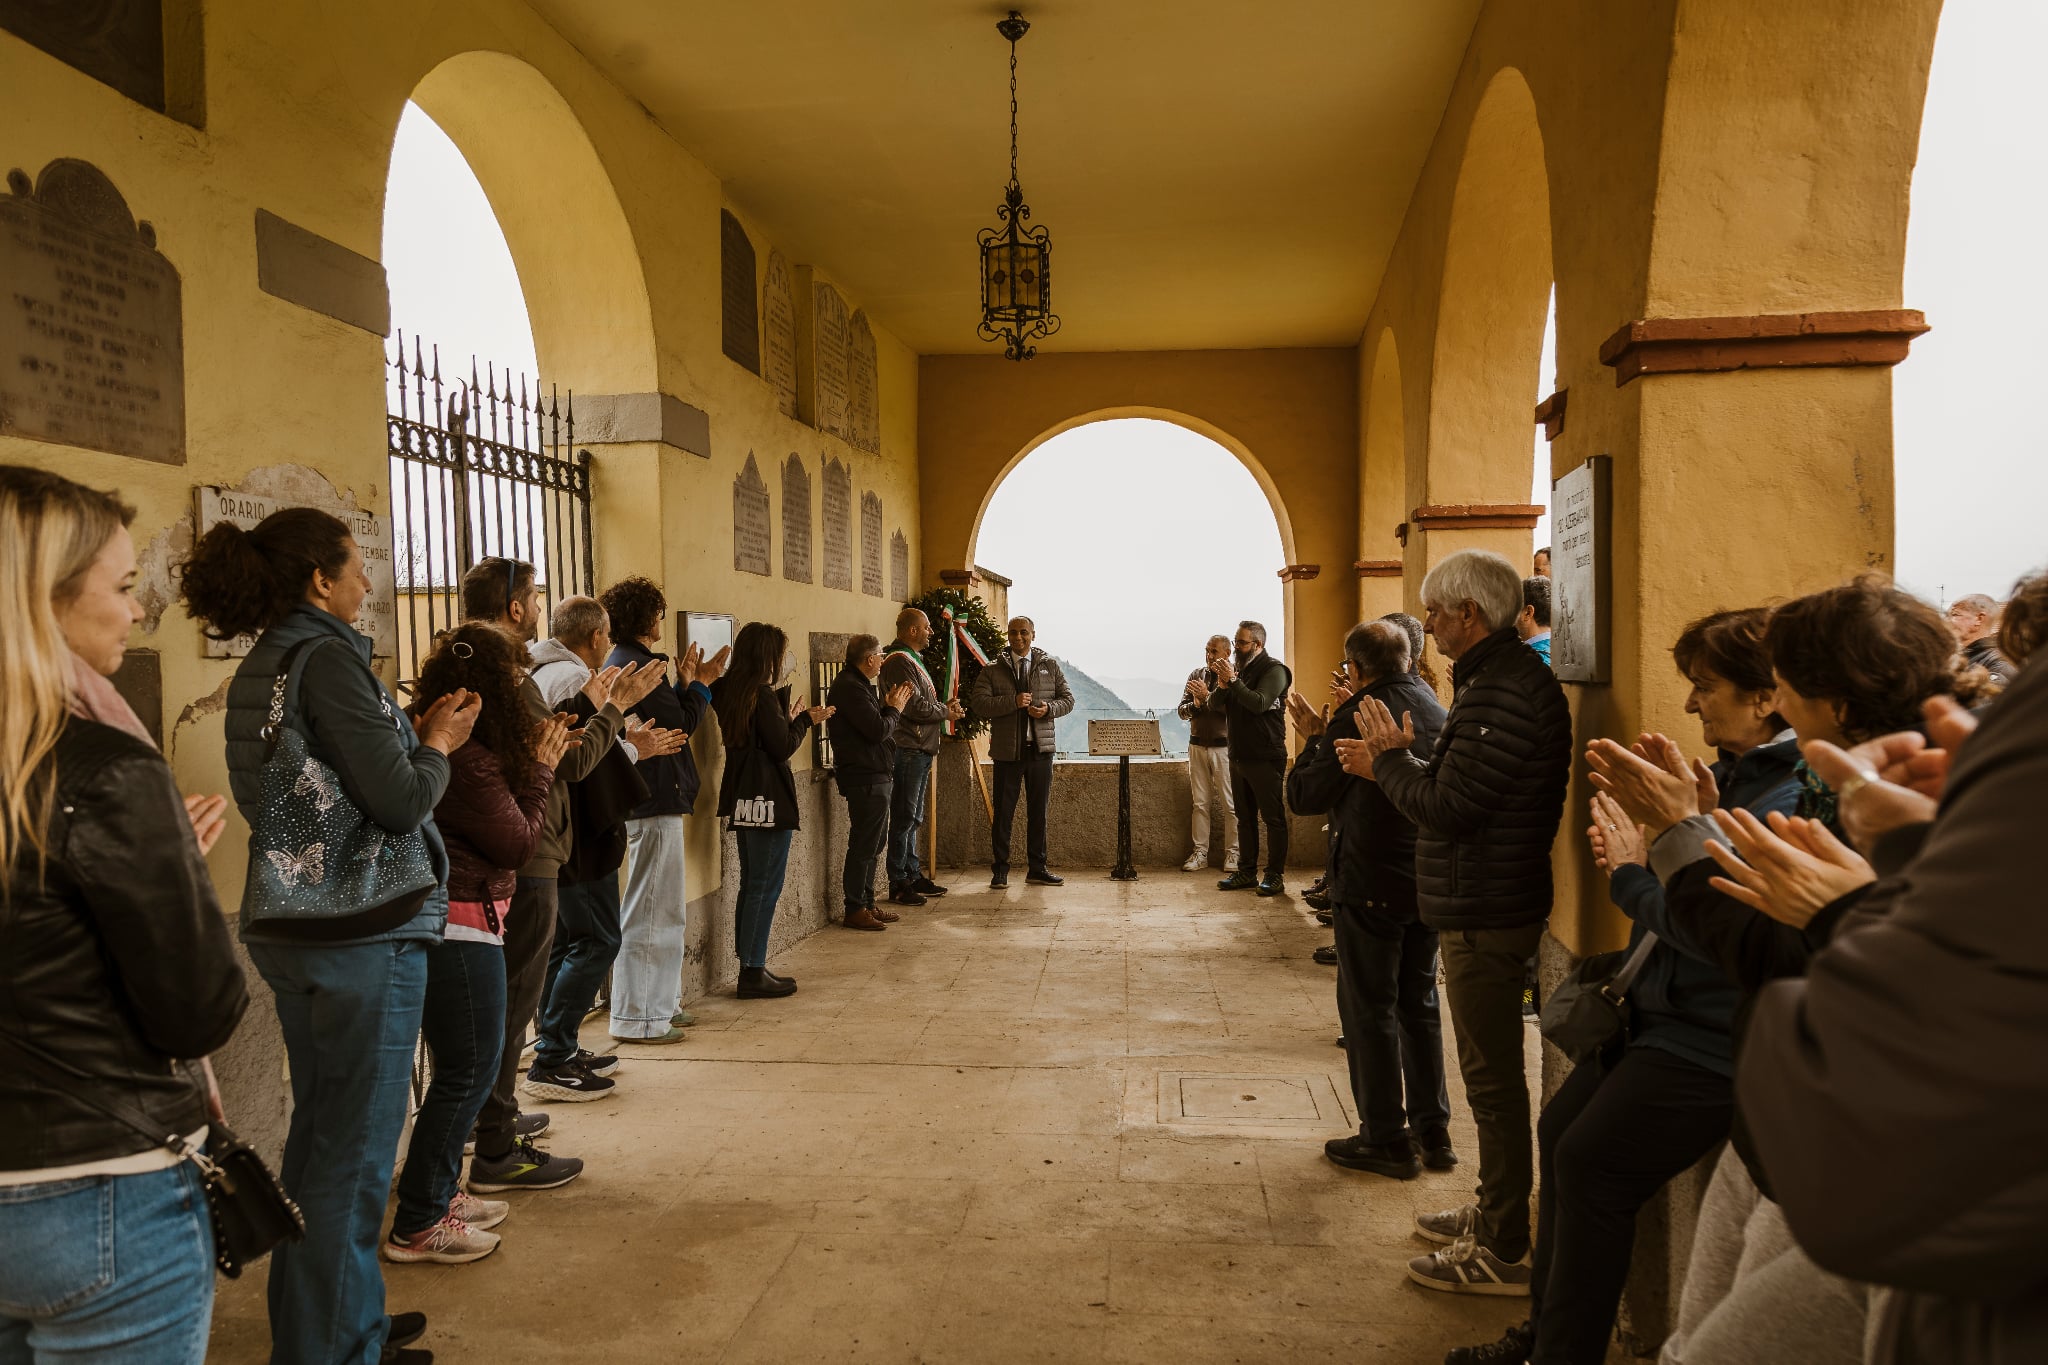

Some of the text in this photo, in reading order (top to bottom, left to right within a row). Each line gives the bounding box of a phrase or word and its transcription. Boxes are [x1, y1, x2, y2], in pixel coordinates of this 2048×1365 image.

[220, 497, 265, 521] ORARIO
[367, 601, 391, 614] MARZO
[368, 620, 375, 631] 16
